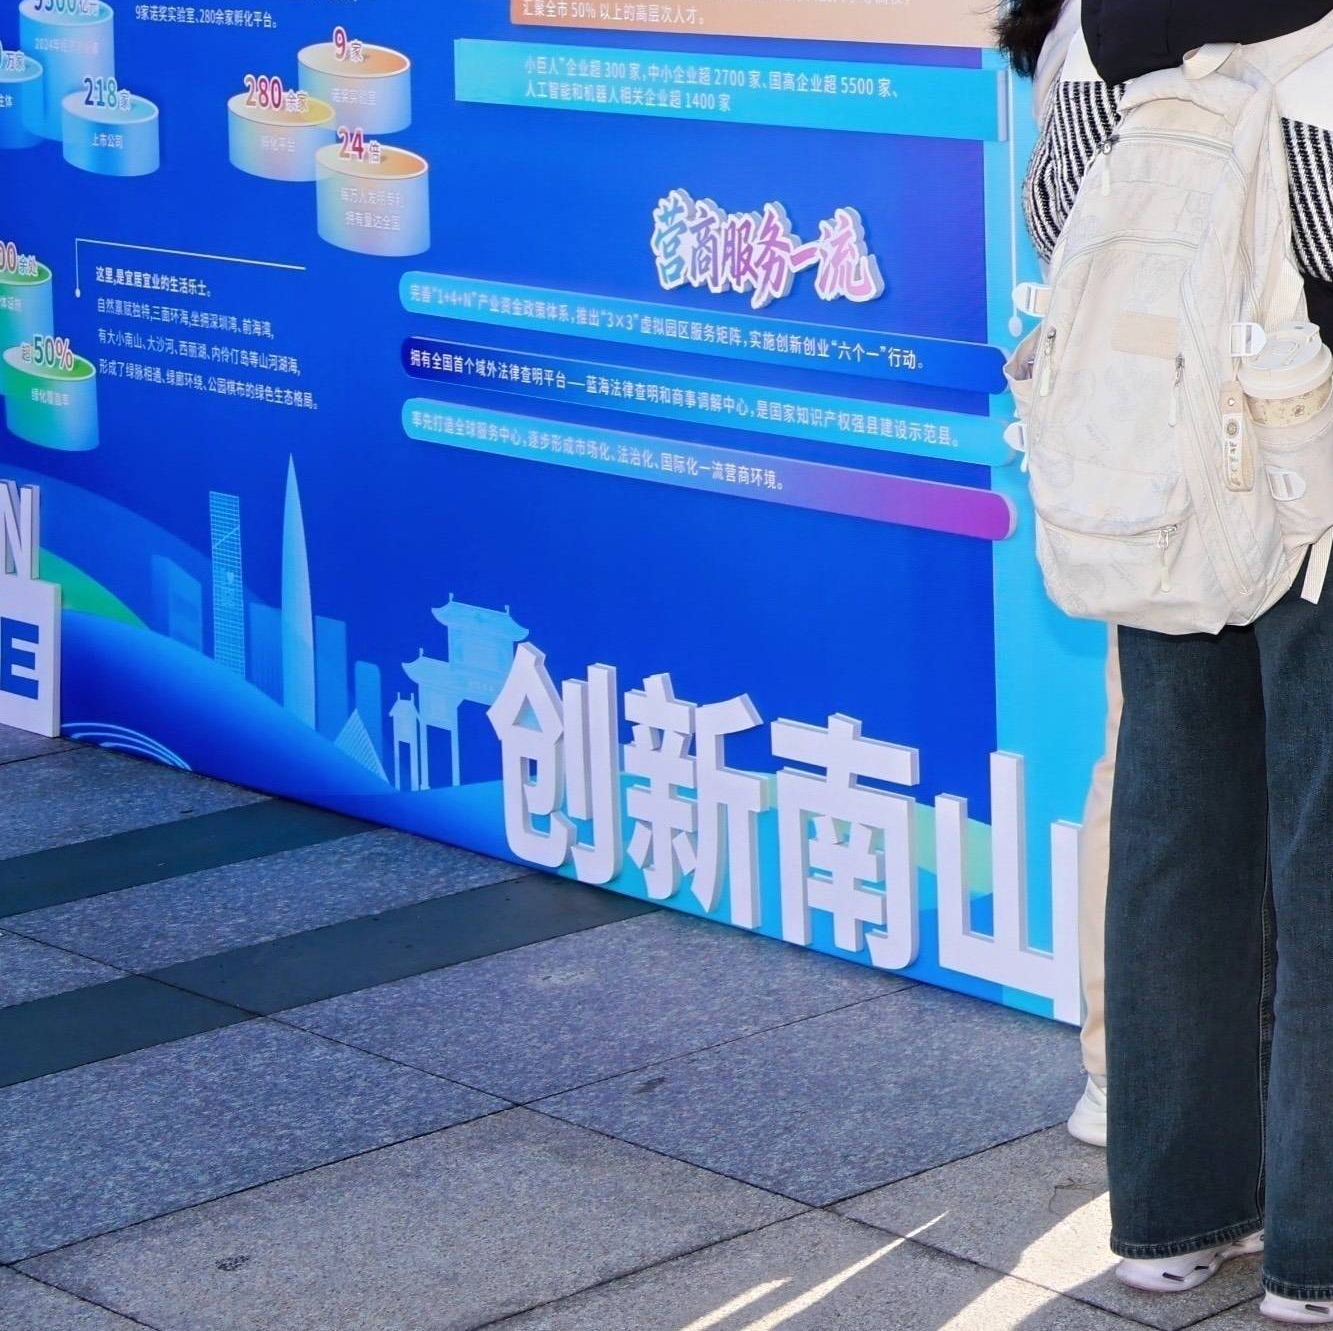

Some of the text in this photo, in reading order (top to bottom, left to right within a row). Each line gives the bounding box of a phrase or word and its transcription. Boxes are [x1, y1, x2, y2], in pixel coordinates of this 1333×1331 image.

[0, 40, 26, 72] 万家
[652, 187, 885, 310] 营商服务一流
[487, 642, 1082, 1027] 创新南山
